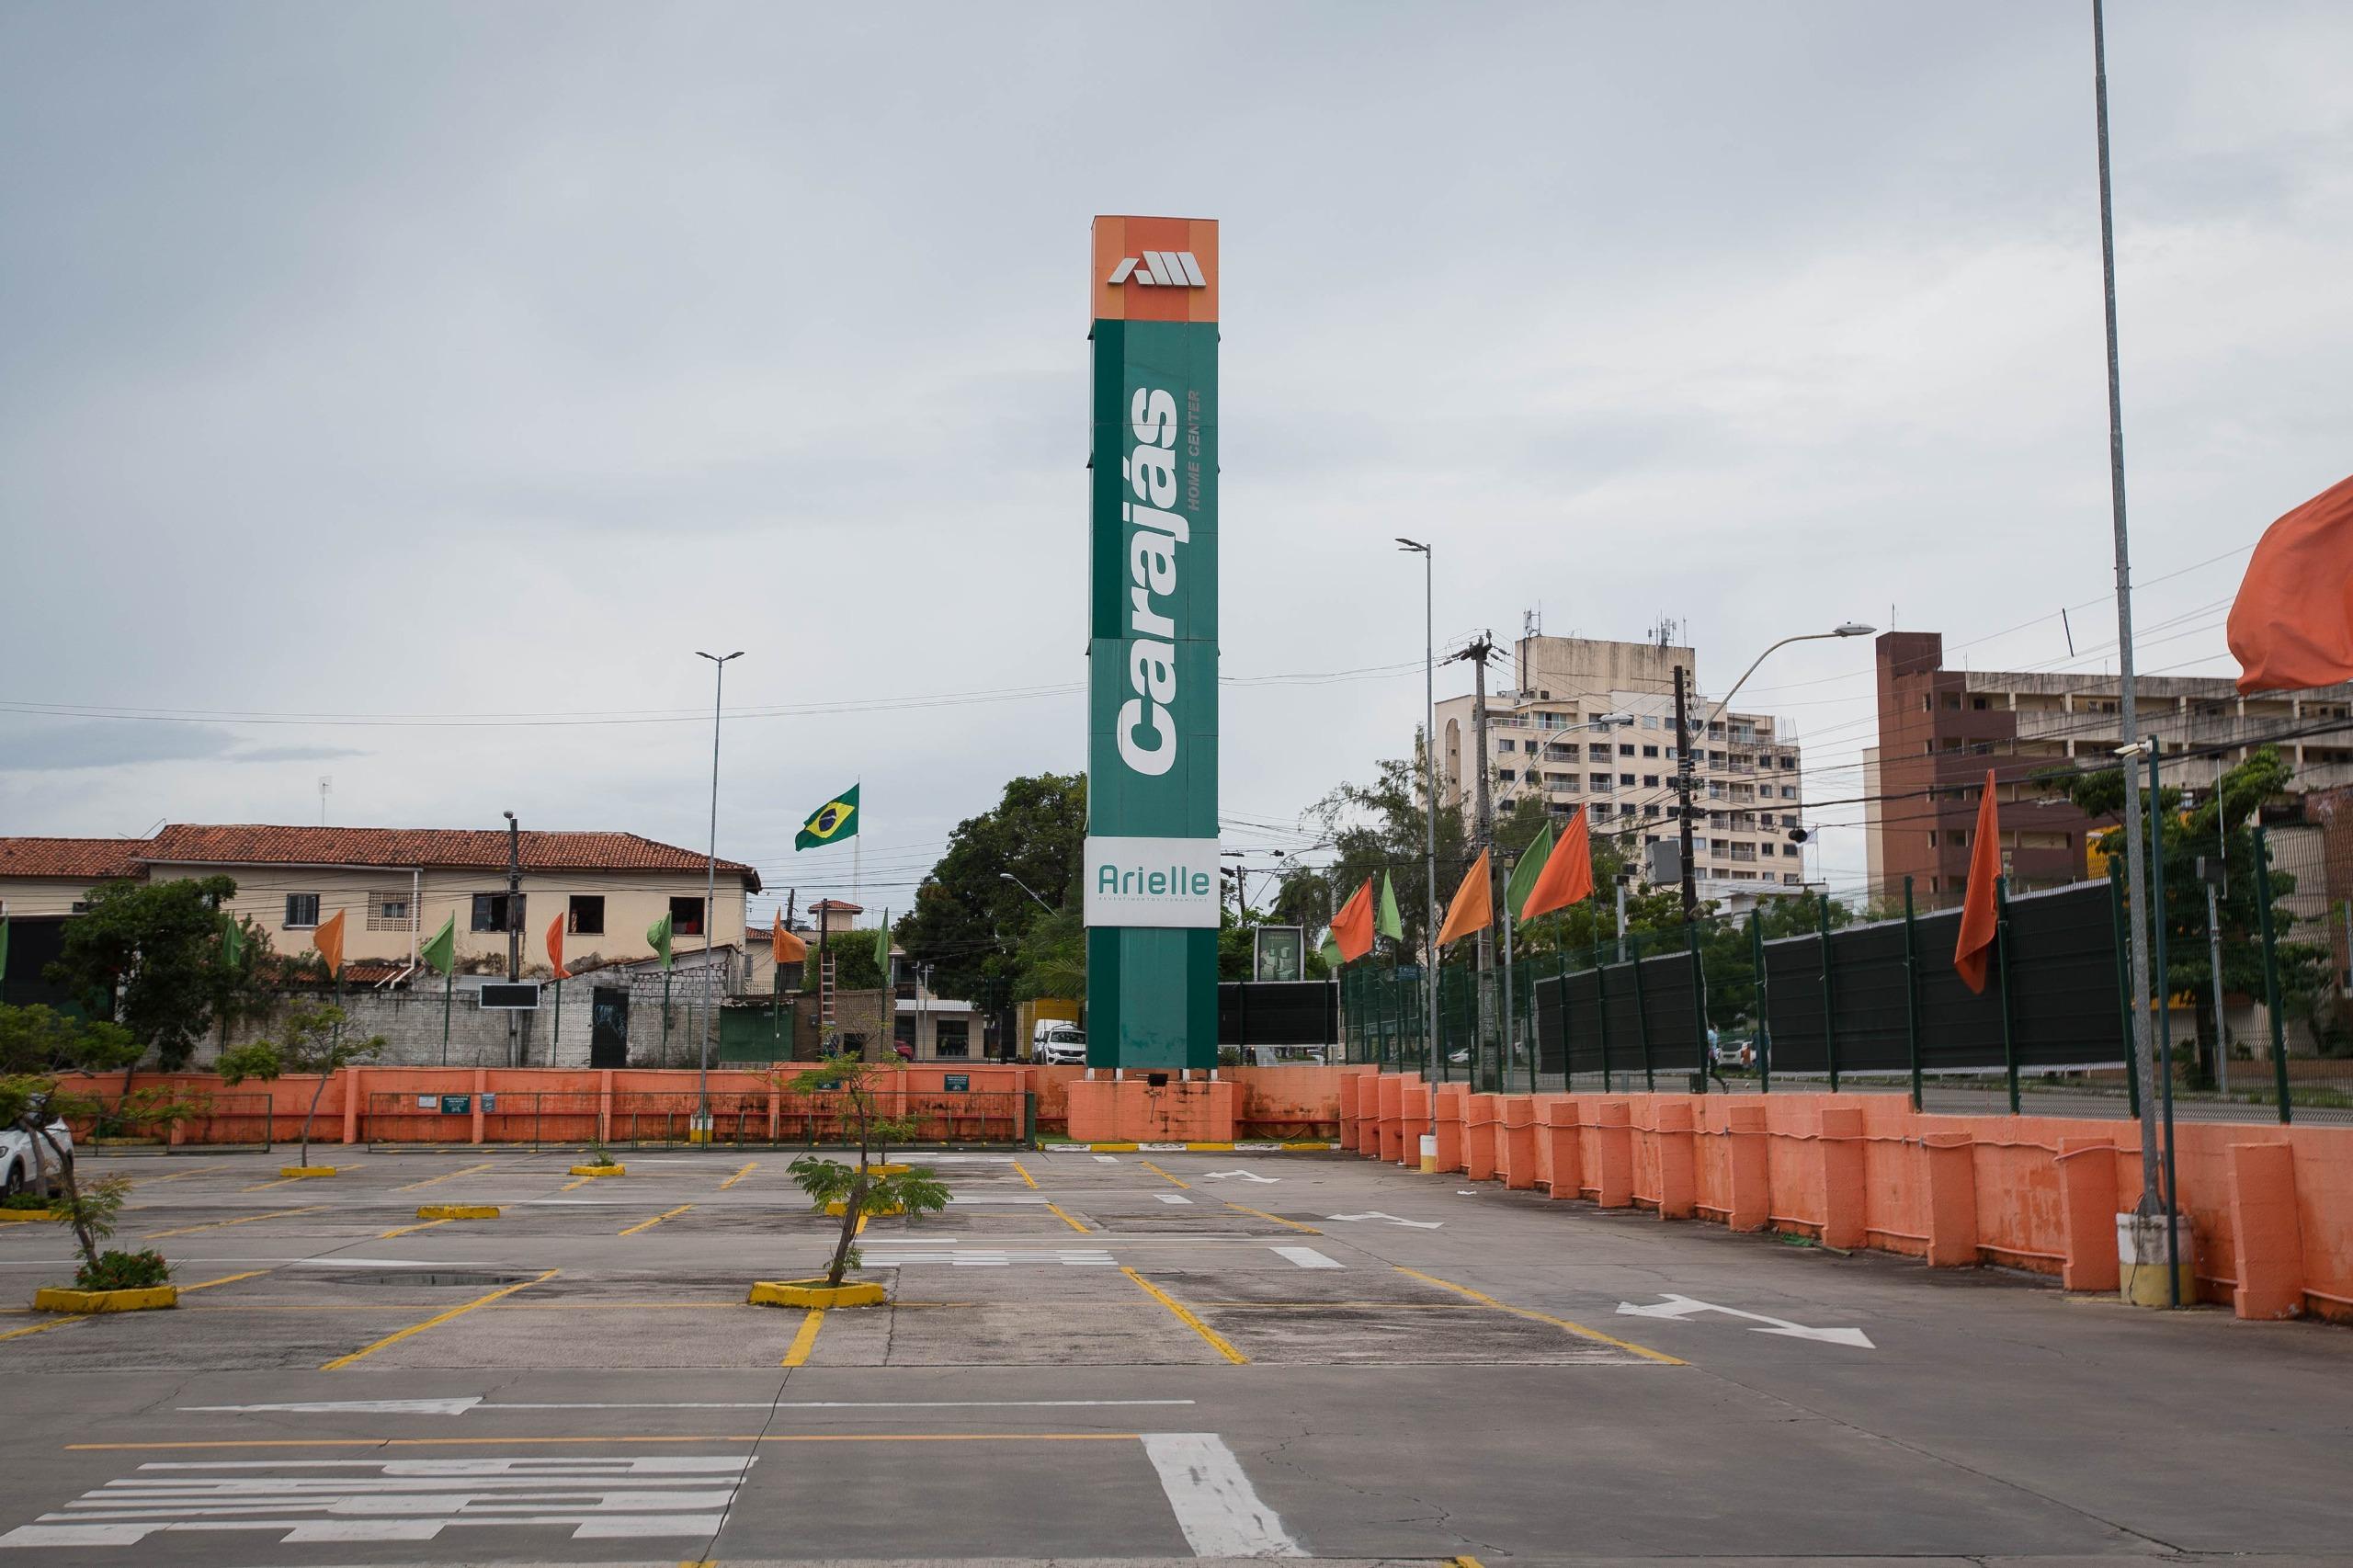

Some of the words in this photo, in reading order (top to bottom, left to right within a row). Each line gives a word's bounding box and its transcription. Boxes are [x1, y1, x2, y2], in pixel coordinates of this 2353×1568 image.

[1188, 390, 1199, 457] CENTER
[1188, 461, 1199, 511] HOME
[1117, 387, 1189, 776] Carajás
[1098, 865, 1210, 895] Arielle
[0, 1456, 759, 1547] PARE
